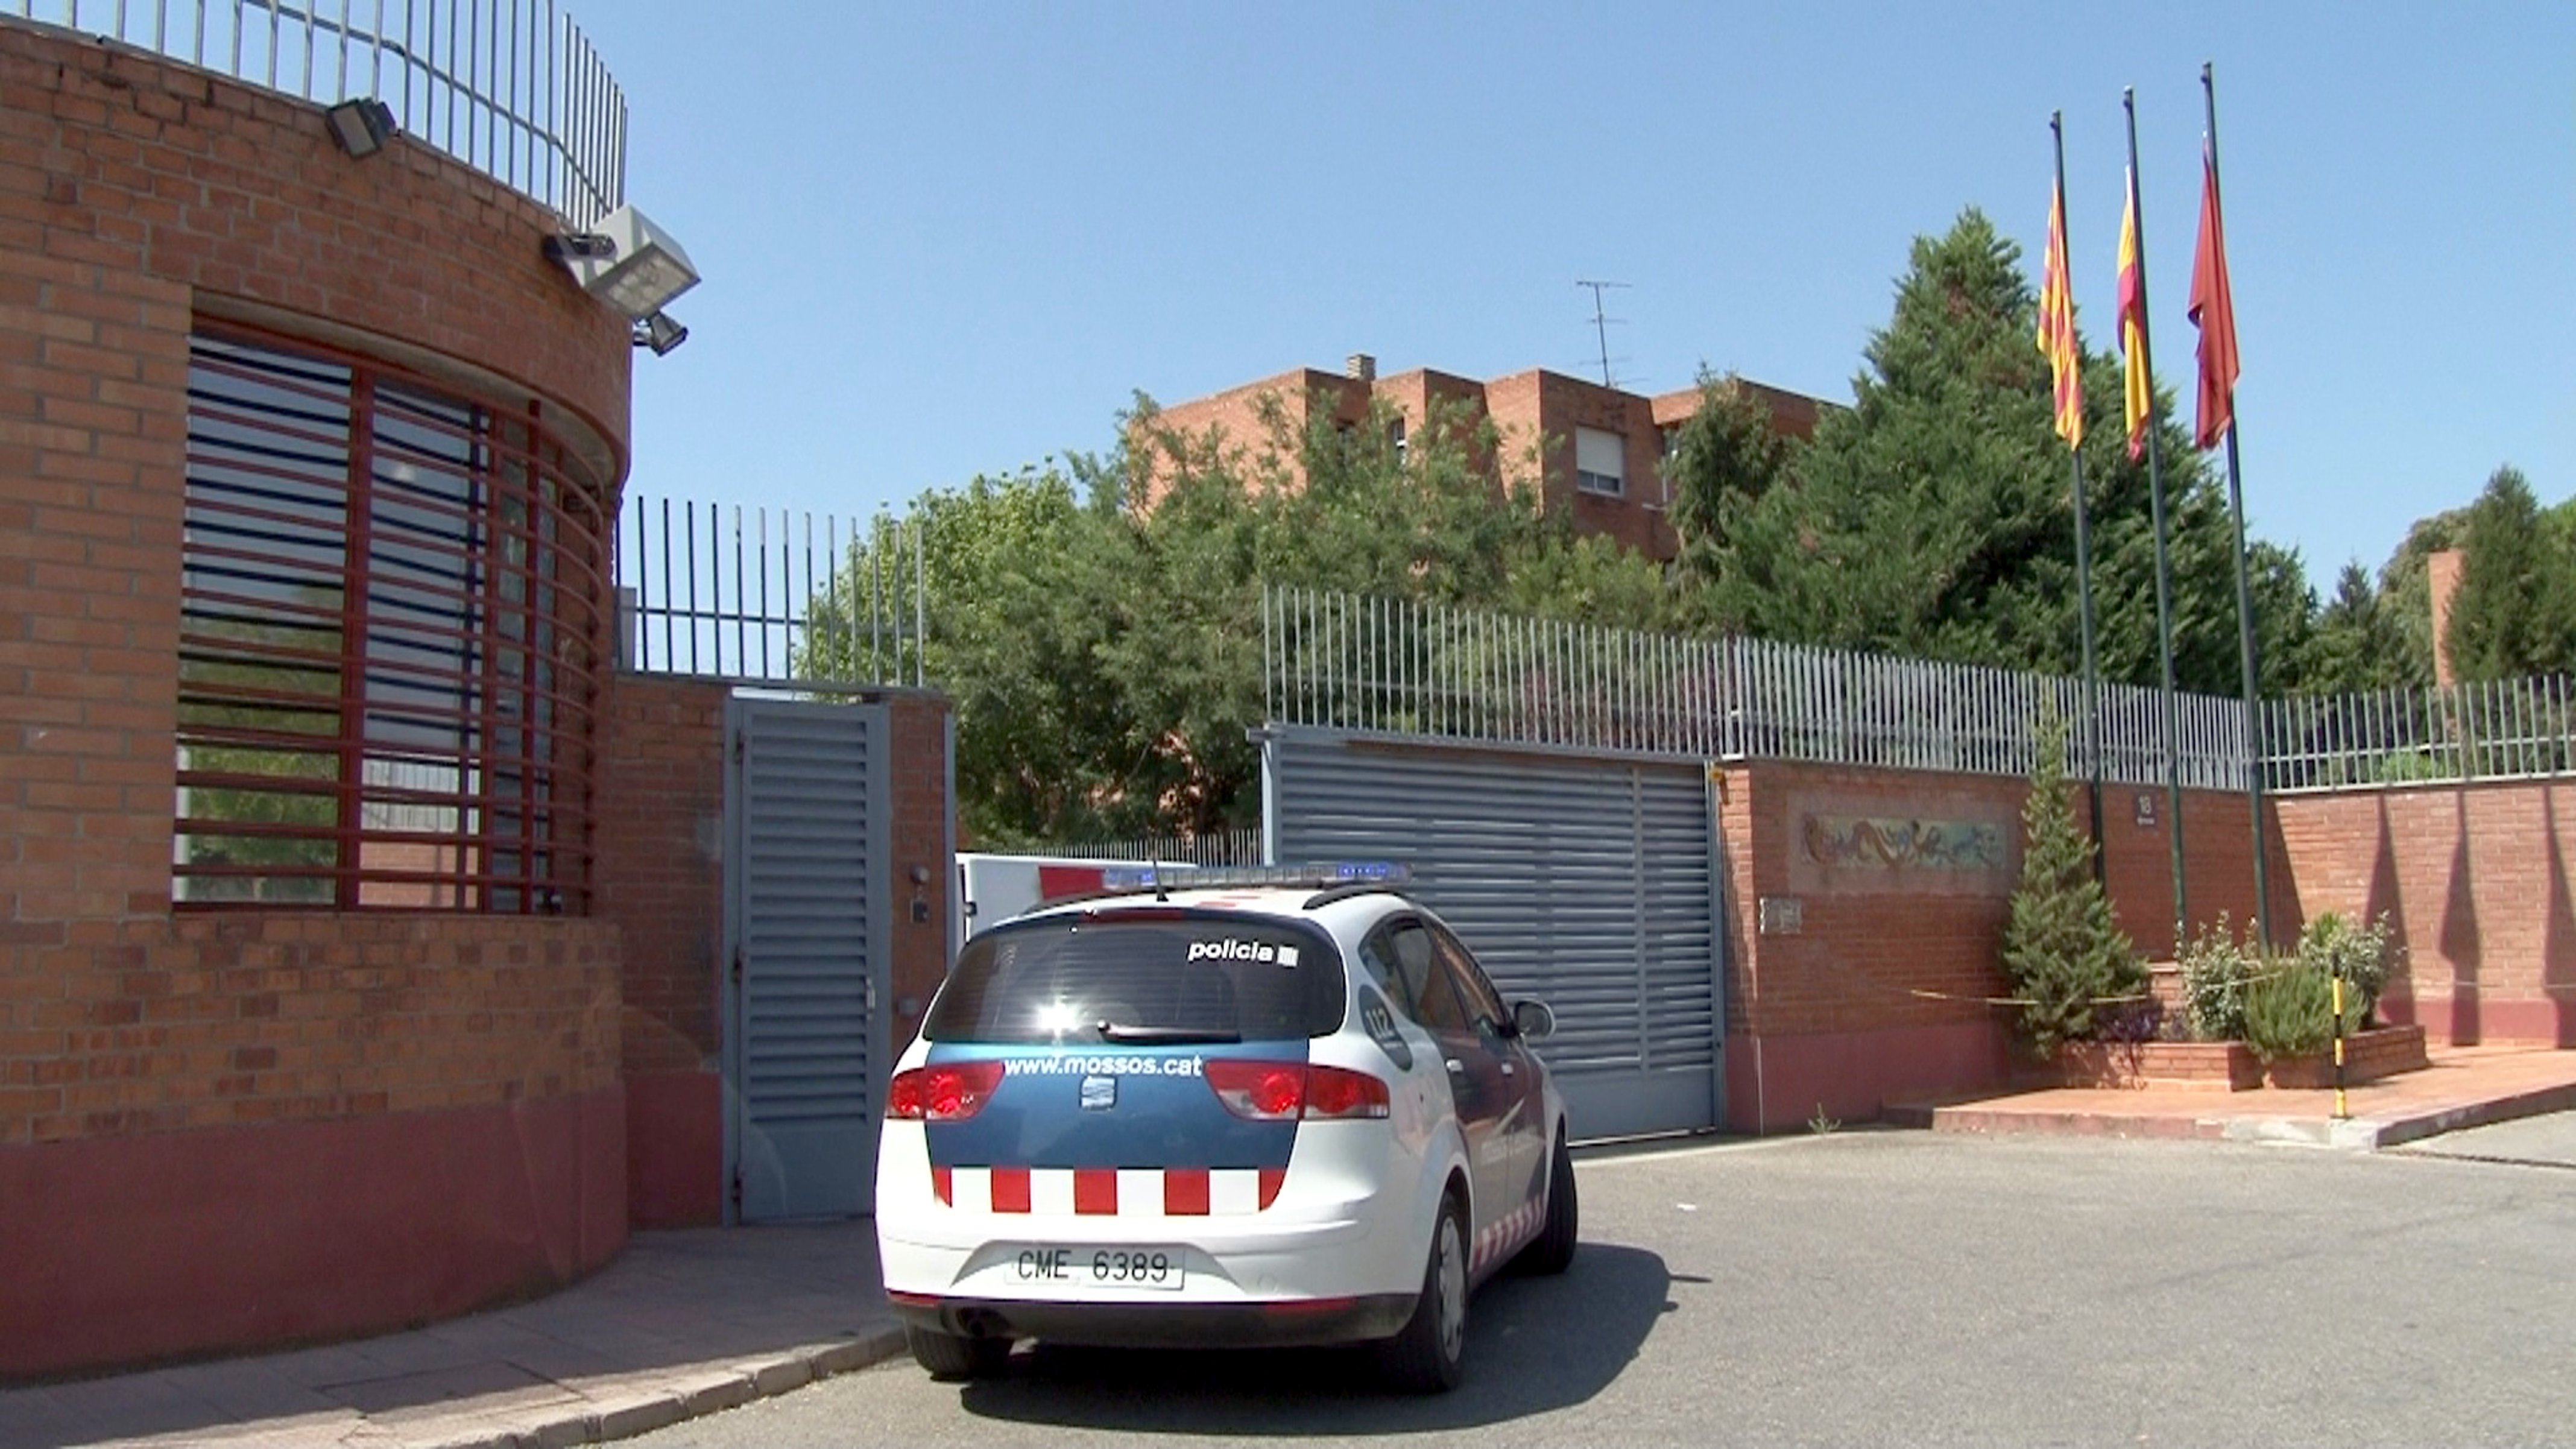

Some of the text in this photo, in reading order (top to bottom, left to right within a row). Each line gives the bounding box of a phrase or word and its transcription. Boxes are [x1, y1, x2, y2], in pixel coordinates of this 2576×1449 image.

[1187, 938, 1274, 962] policia
[1365, 1008, 1395, 1039] 112
[1004, 1055, 1203, 1076] www.mossos.cat
[1018, 1250, 1167, 1282] CME 6389
